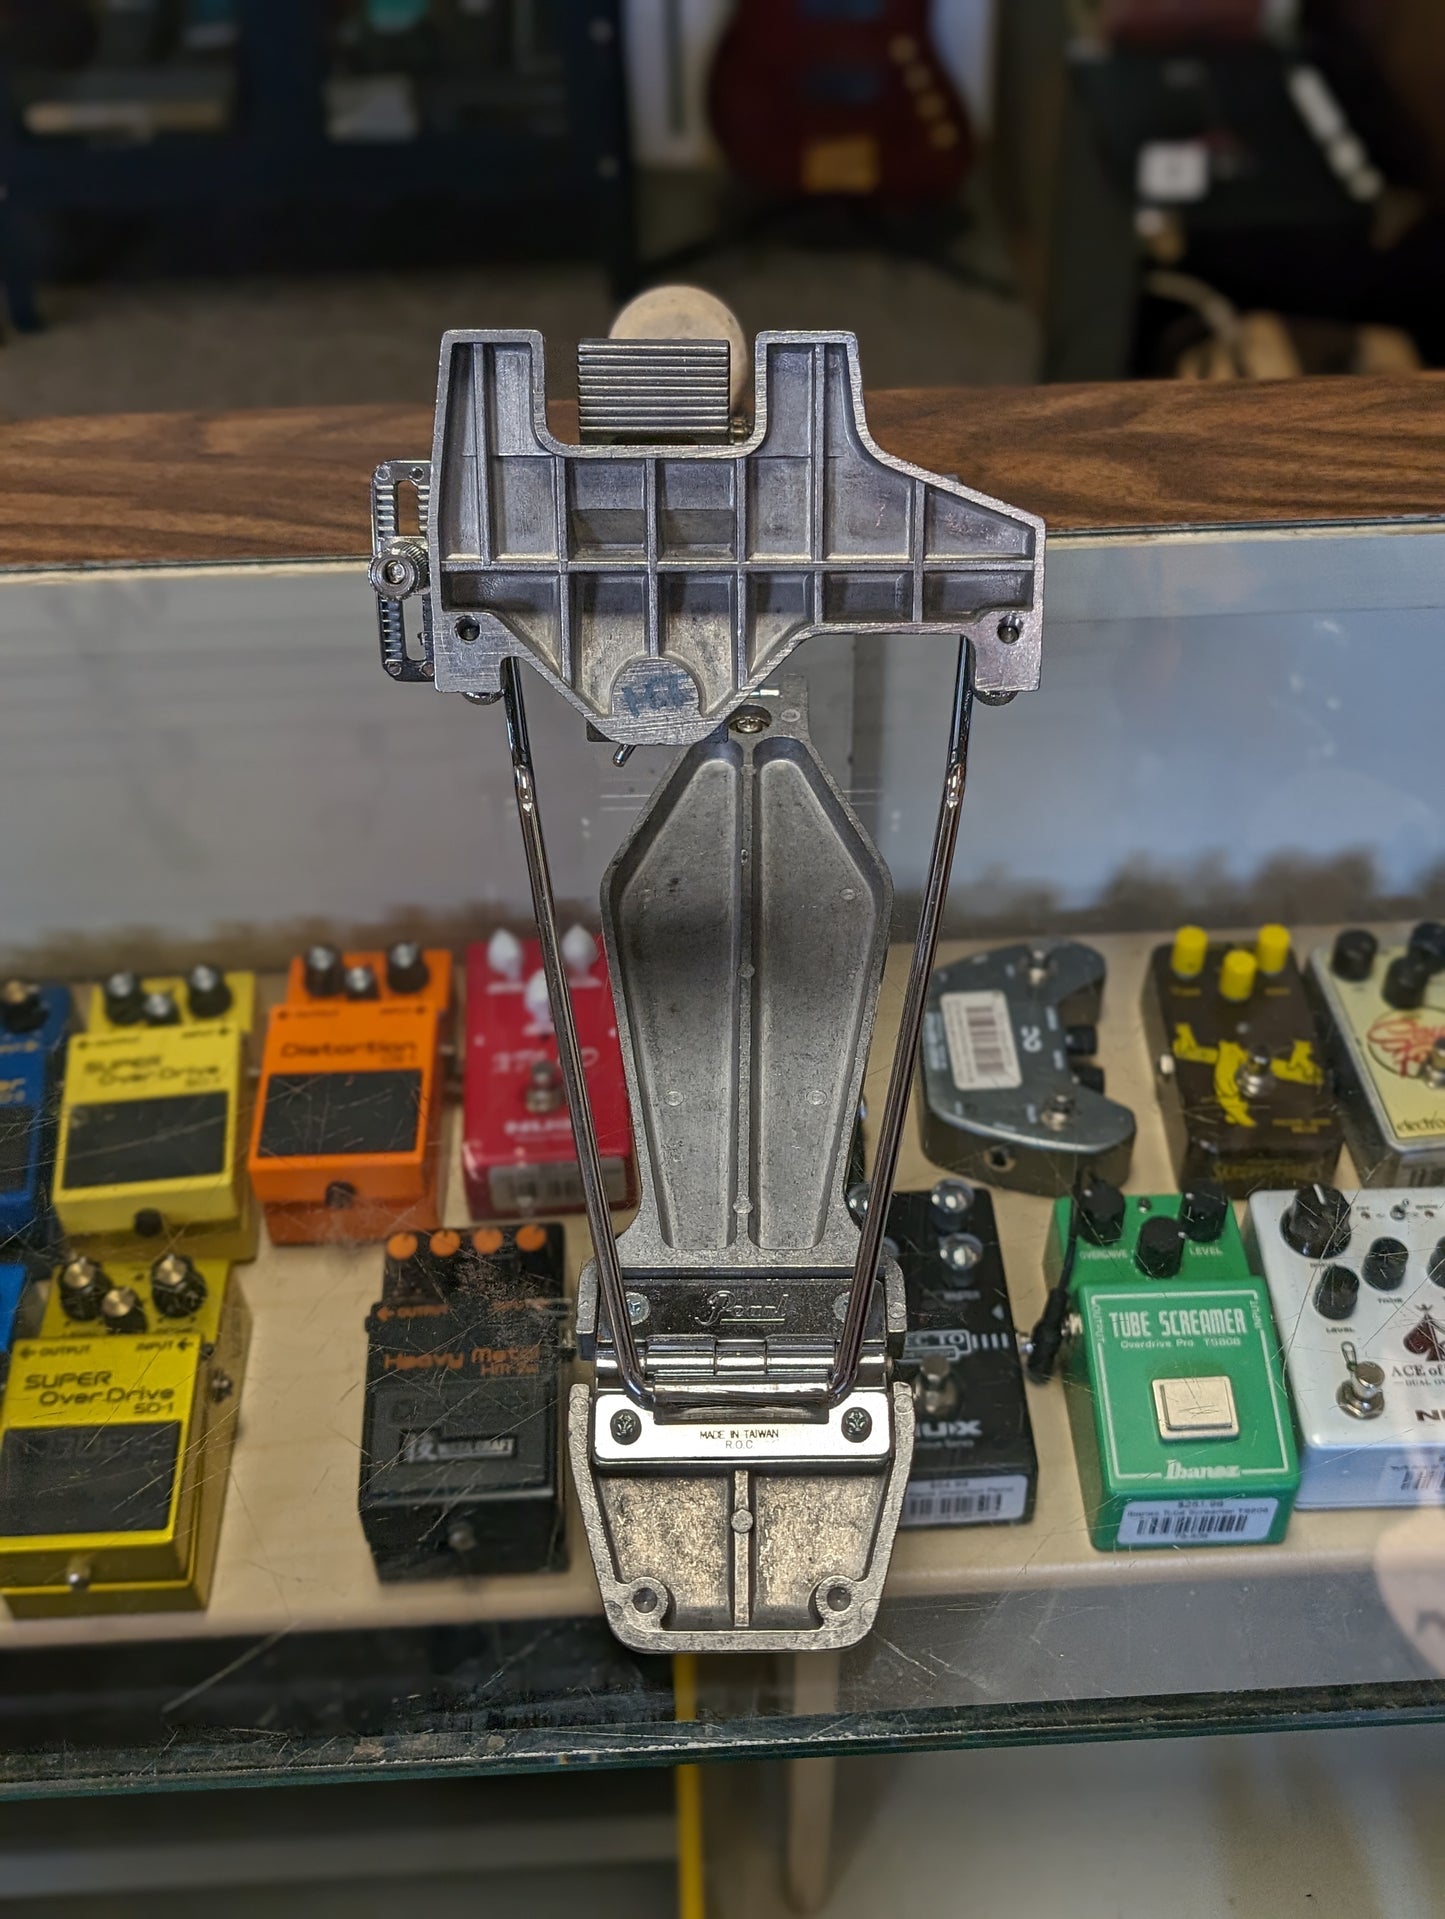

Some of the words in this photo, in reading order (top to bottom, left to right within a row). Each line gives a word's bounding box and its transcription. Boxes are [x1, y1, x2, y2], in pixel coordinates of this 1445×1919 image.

[280, 1041, 417, 1058] Distortion
[1189, 1246, 1223, 1256] LEVEL
[694, 1290, 794, 1326] Pearl
[1109, 1311, 1152, 1338] TUBE
[1158, 1308, 1247, 1336] SCREAMER
[38, 1344, 91, 1357] OUTPUT
[136, 1340, 174, 1352] INPUT
[1121, 1339, 1172, 1349] Overdrive
[1176, 1338, 1195, 1347] Pro
[384, 1353, 465, 1371] Heavy
[1391, 1365, 1425, 1378] ACE
[24, 1370, 113, 1391] SUPER
[700, 1430, 725, 1440] MADE
[730, 1430, 740, 1439] IN
[744, 1428, 779, 1439] TAIWAN
[1164, 1459, 1241, 1480] Ibanez
